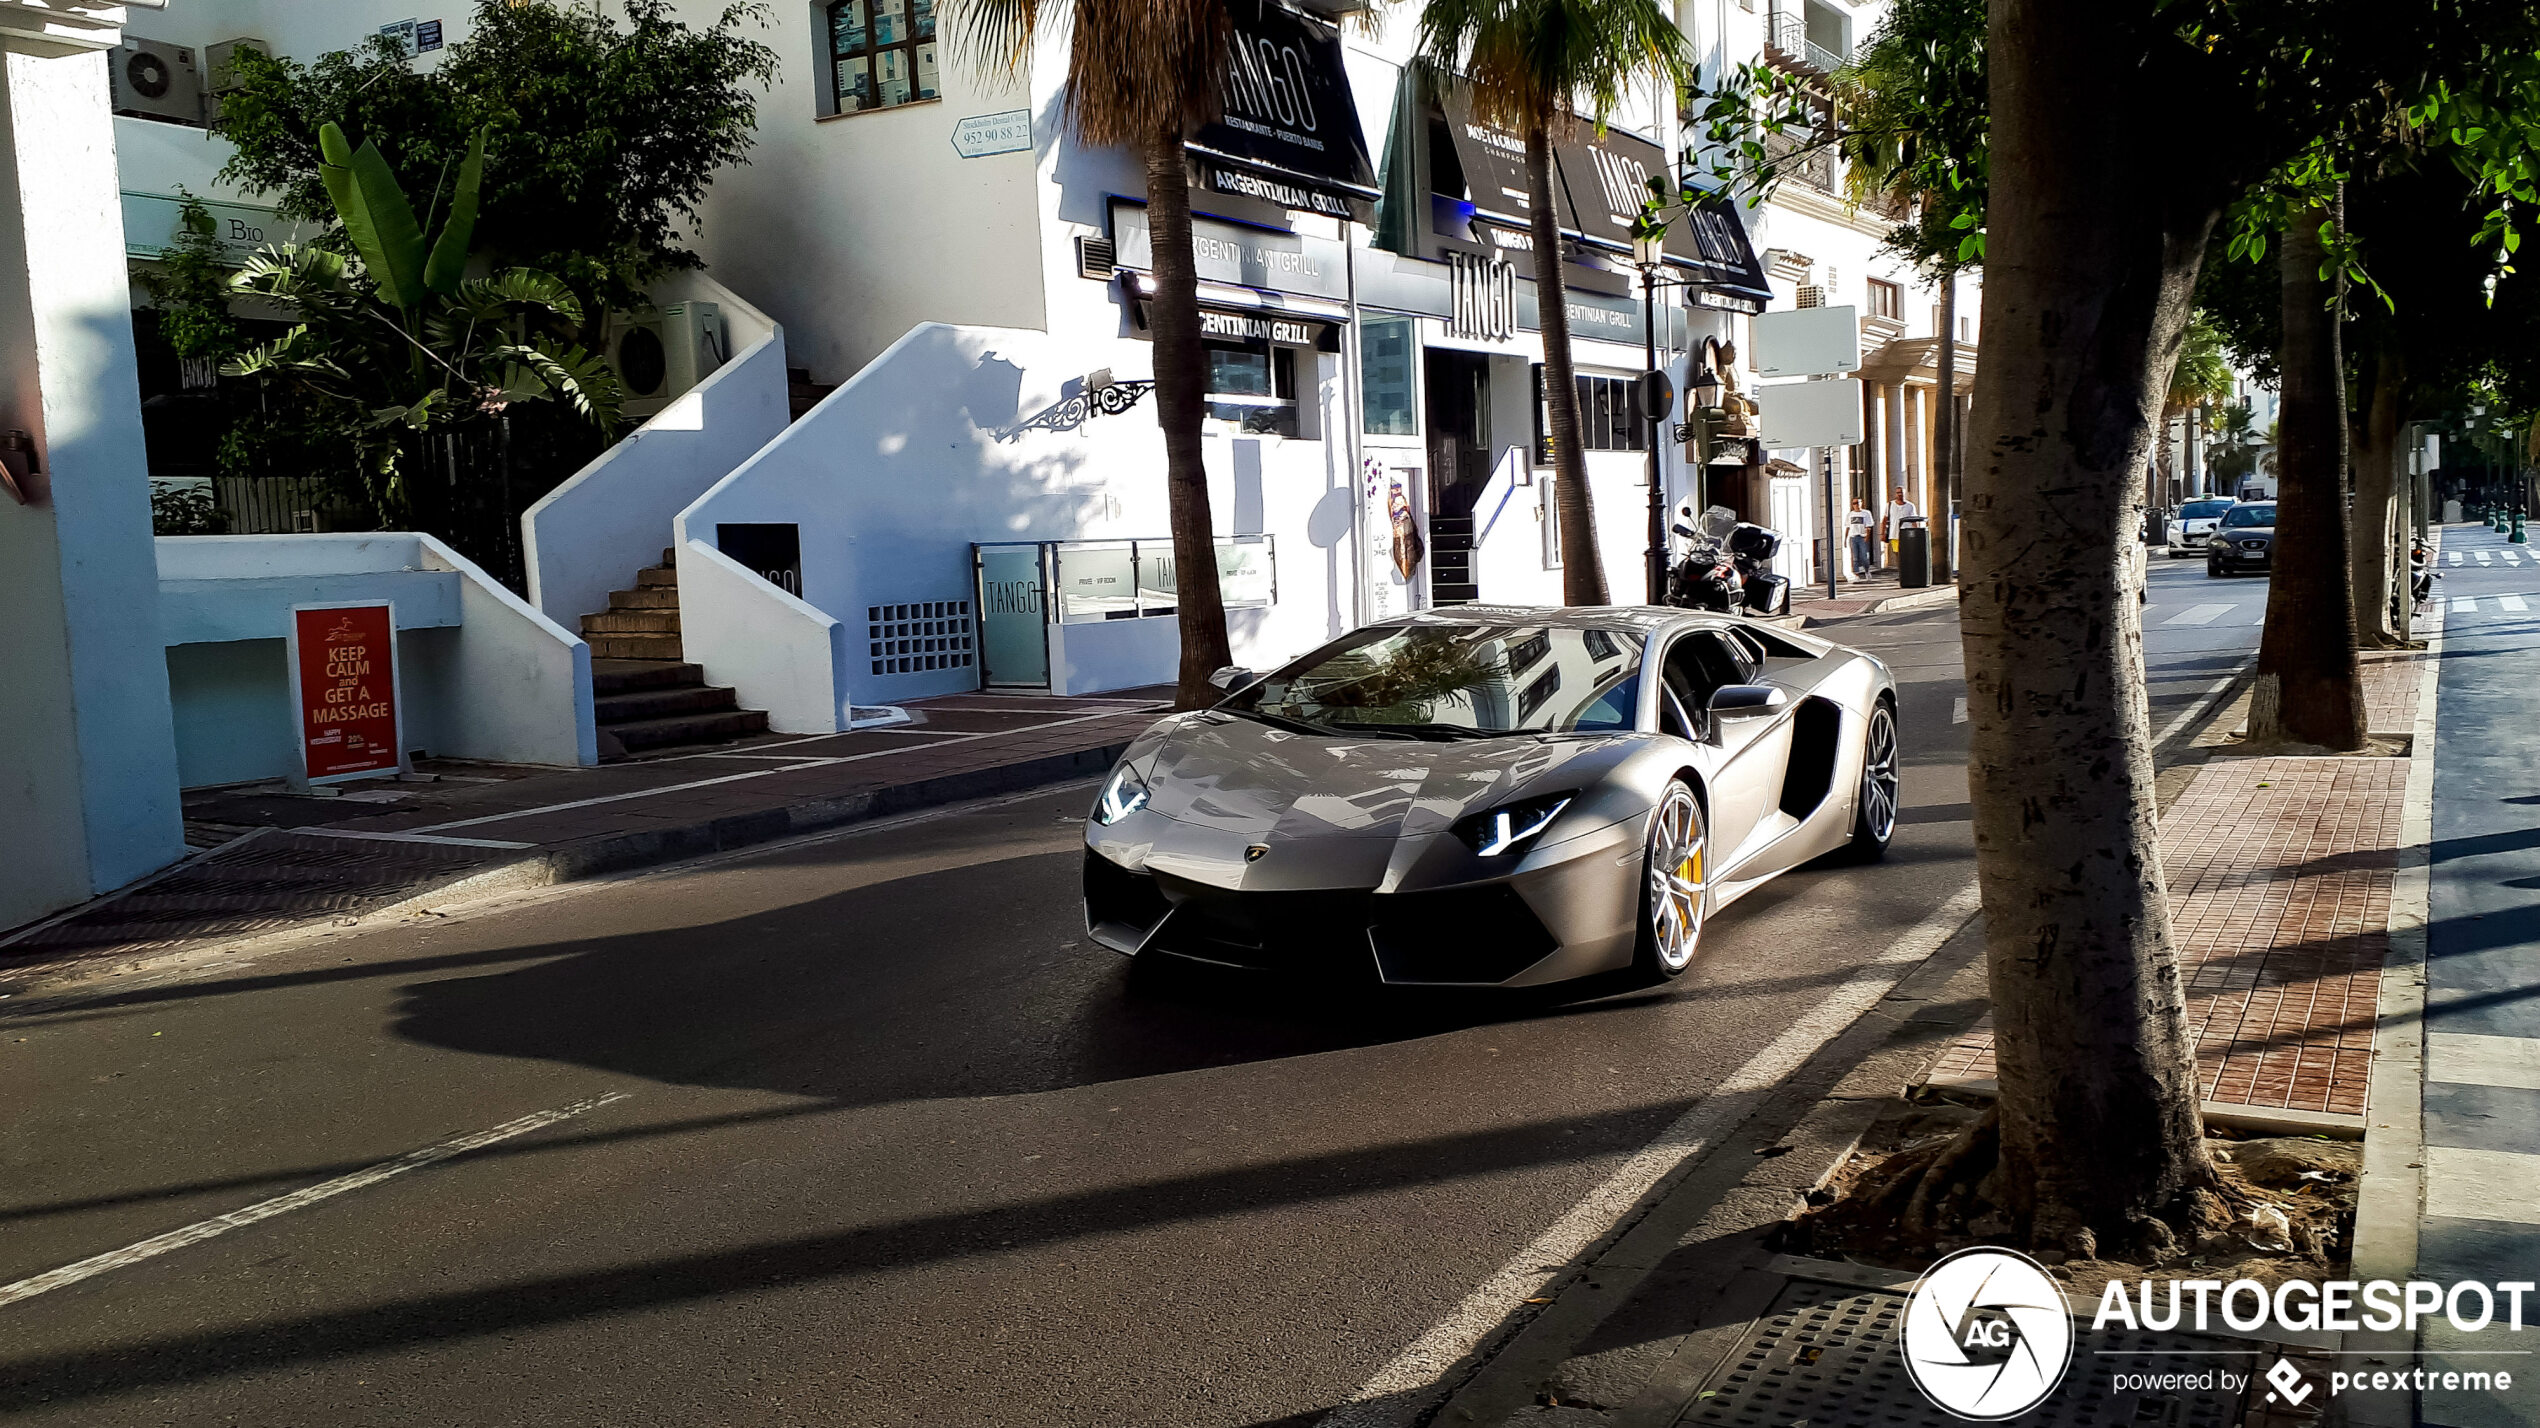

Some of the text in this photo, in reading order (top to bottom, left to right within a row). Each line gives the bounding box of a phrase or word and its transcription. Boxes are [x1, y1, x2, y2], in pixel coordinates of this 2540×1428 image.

[964, 124, 1028, 145] 952 90 88 22
[1224, 114, 1273, 137] RESTAURANTE
[1276, 129, 1303, 145] PUERTO
[1484, 146, 1527, 165] CHAMPAGN
[1499, 135, 1527, 154] CHAN
[1587, 144, 1656, 216] TANGO
[1215, 169, 1351, 217] ARGENTINIAN GRILL
[1490, 228, 1528, 251] TANGO
[1192, 234, 1321, 277] RGENTINIAN GRILL
[1448, 251, 1517, 340] TANGO
[1564, 303, 1632, 328] GENTINIAN GRILL
[1198, 312, 1311, 345] GENTINIAN GRILL
[1155, 557, 1176, 588] TAN
[986, 580, 1038, 614] TANGO
[329, 646, 366, 663] KEEP
[326, 661, 370, 678] CALM
[338, 674, 359, 687] and
[325, 685, 371, 704] GET A
[312, 702, 389, 723] MASSAGE
